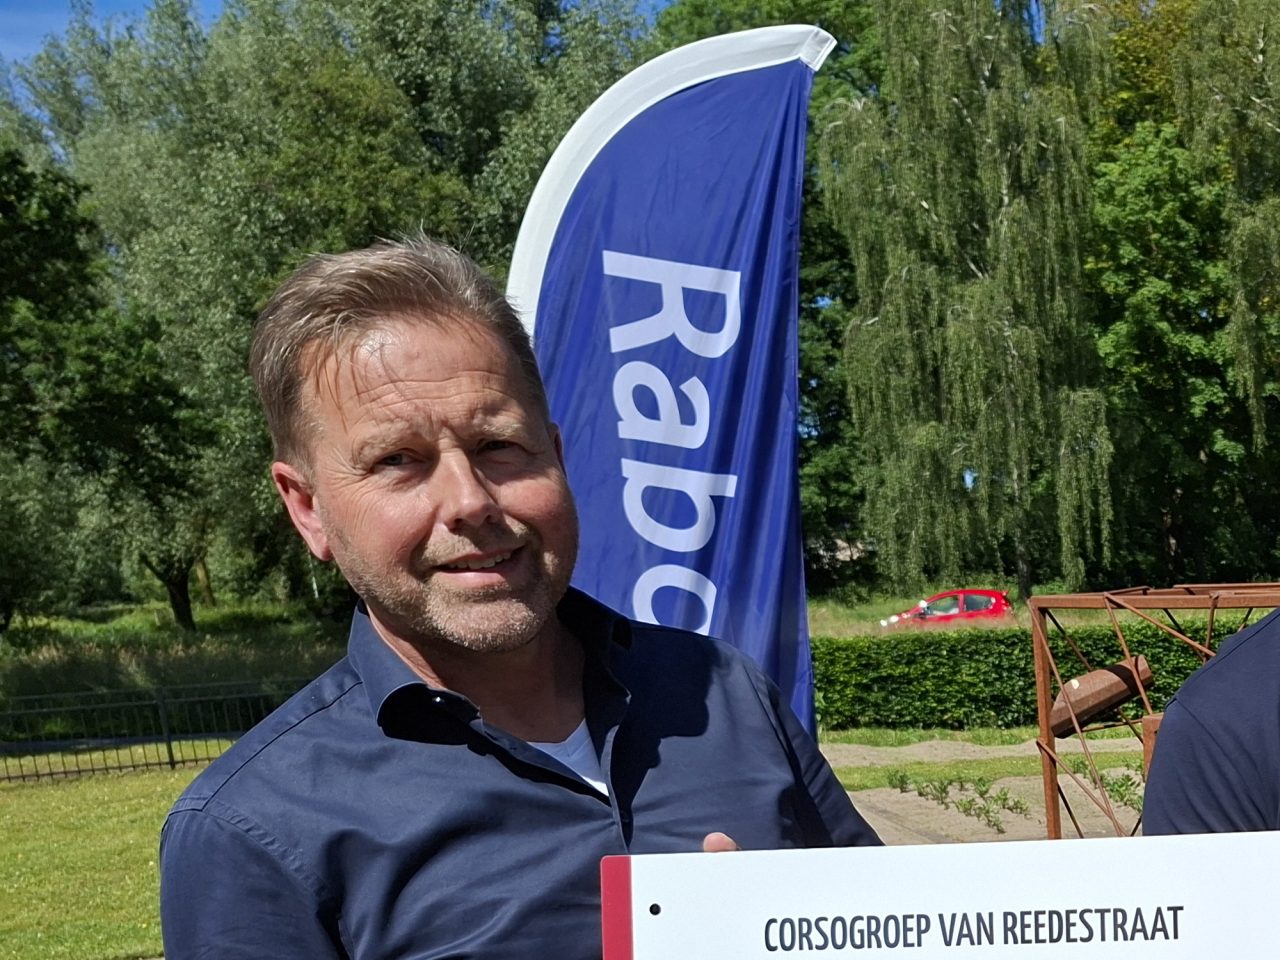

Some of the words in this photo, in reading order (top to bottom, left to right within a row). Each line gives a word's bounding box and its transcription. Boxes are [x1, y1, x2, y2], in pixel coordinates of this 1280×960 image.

[765, 914, 930, 951] CORSOGROEP
[938, 912, 994, 946] VAN
[1003, 906, 1183, 944] REEDESTRAAT
